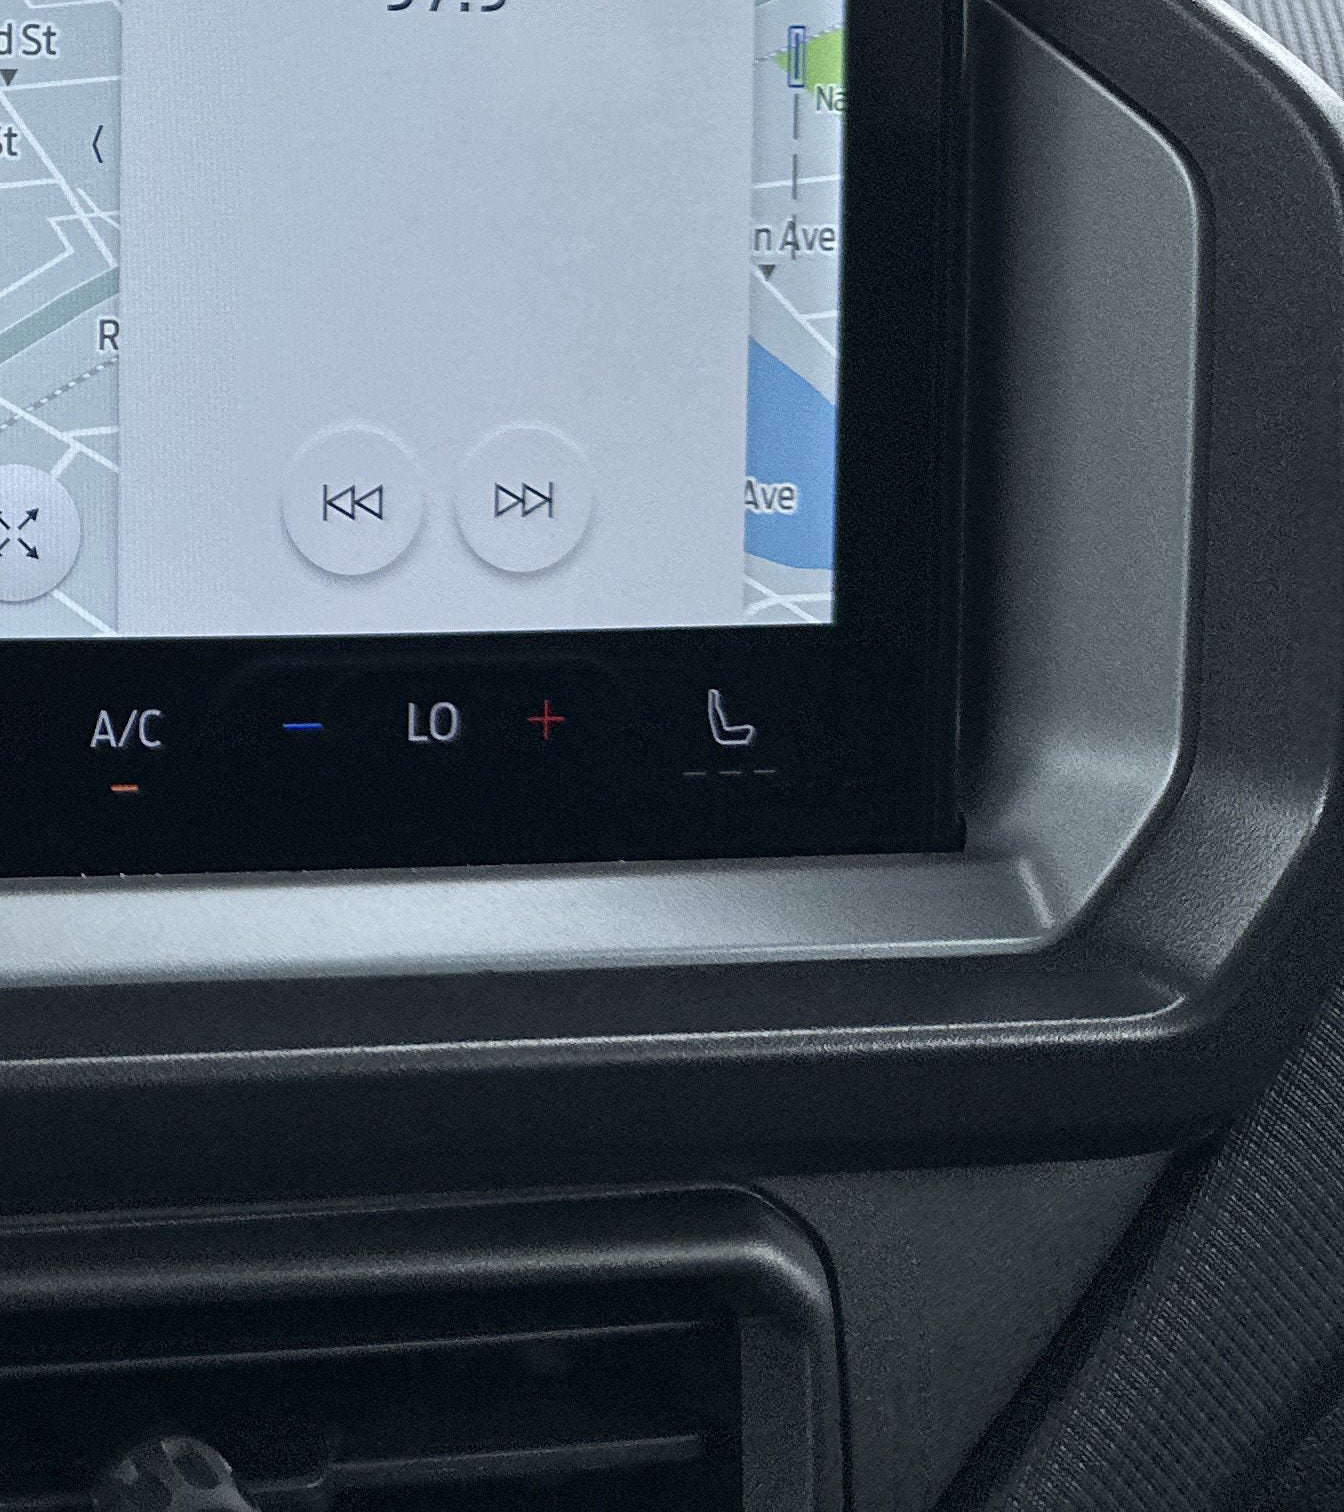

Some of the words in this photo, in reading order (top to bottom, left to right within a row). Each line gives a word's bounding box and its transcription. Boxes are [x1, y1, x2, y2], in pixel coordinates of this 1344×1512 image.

[20, 24, 57, 56] St
[779, 220, 836, 252] Ave
[744, 480, 796, 511] Ave
[91, 709, 163, 749] A/C
[407, 701, 461, 743] LO
